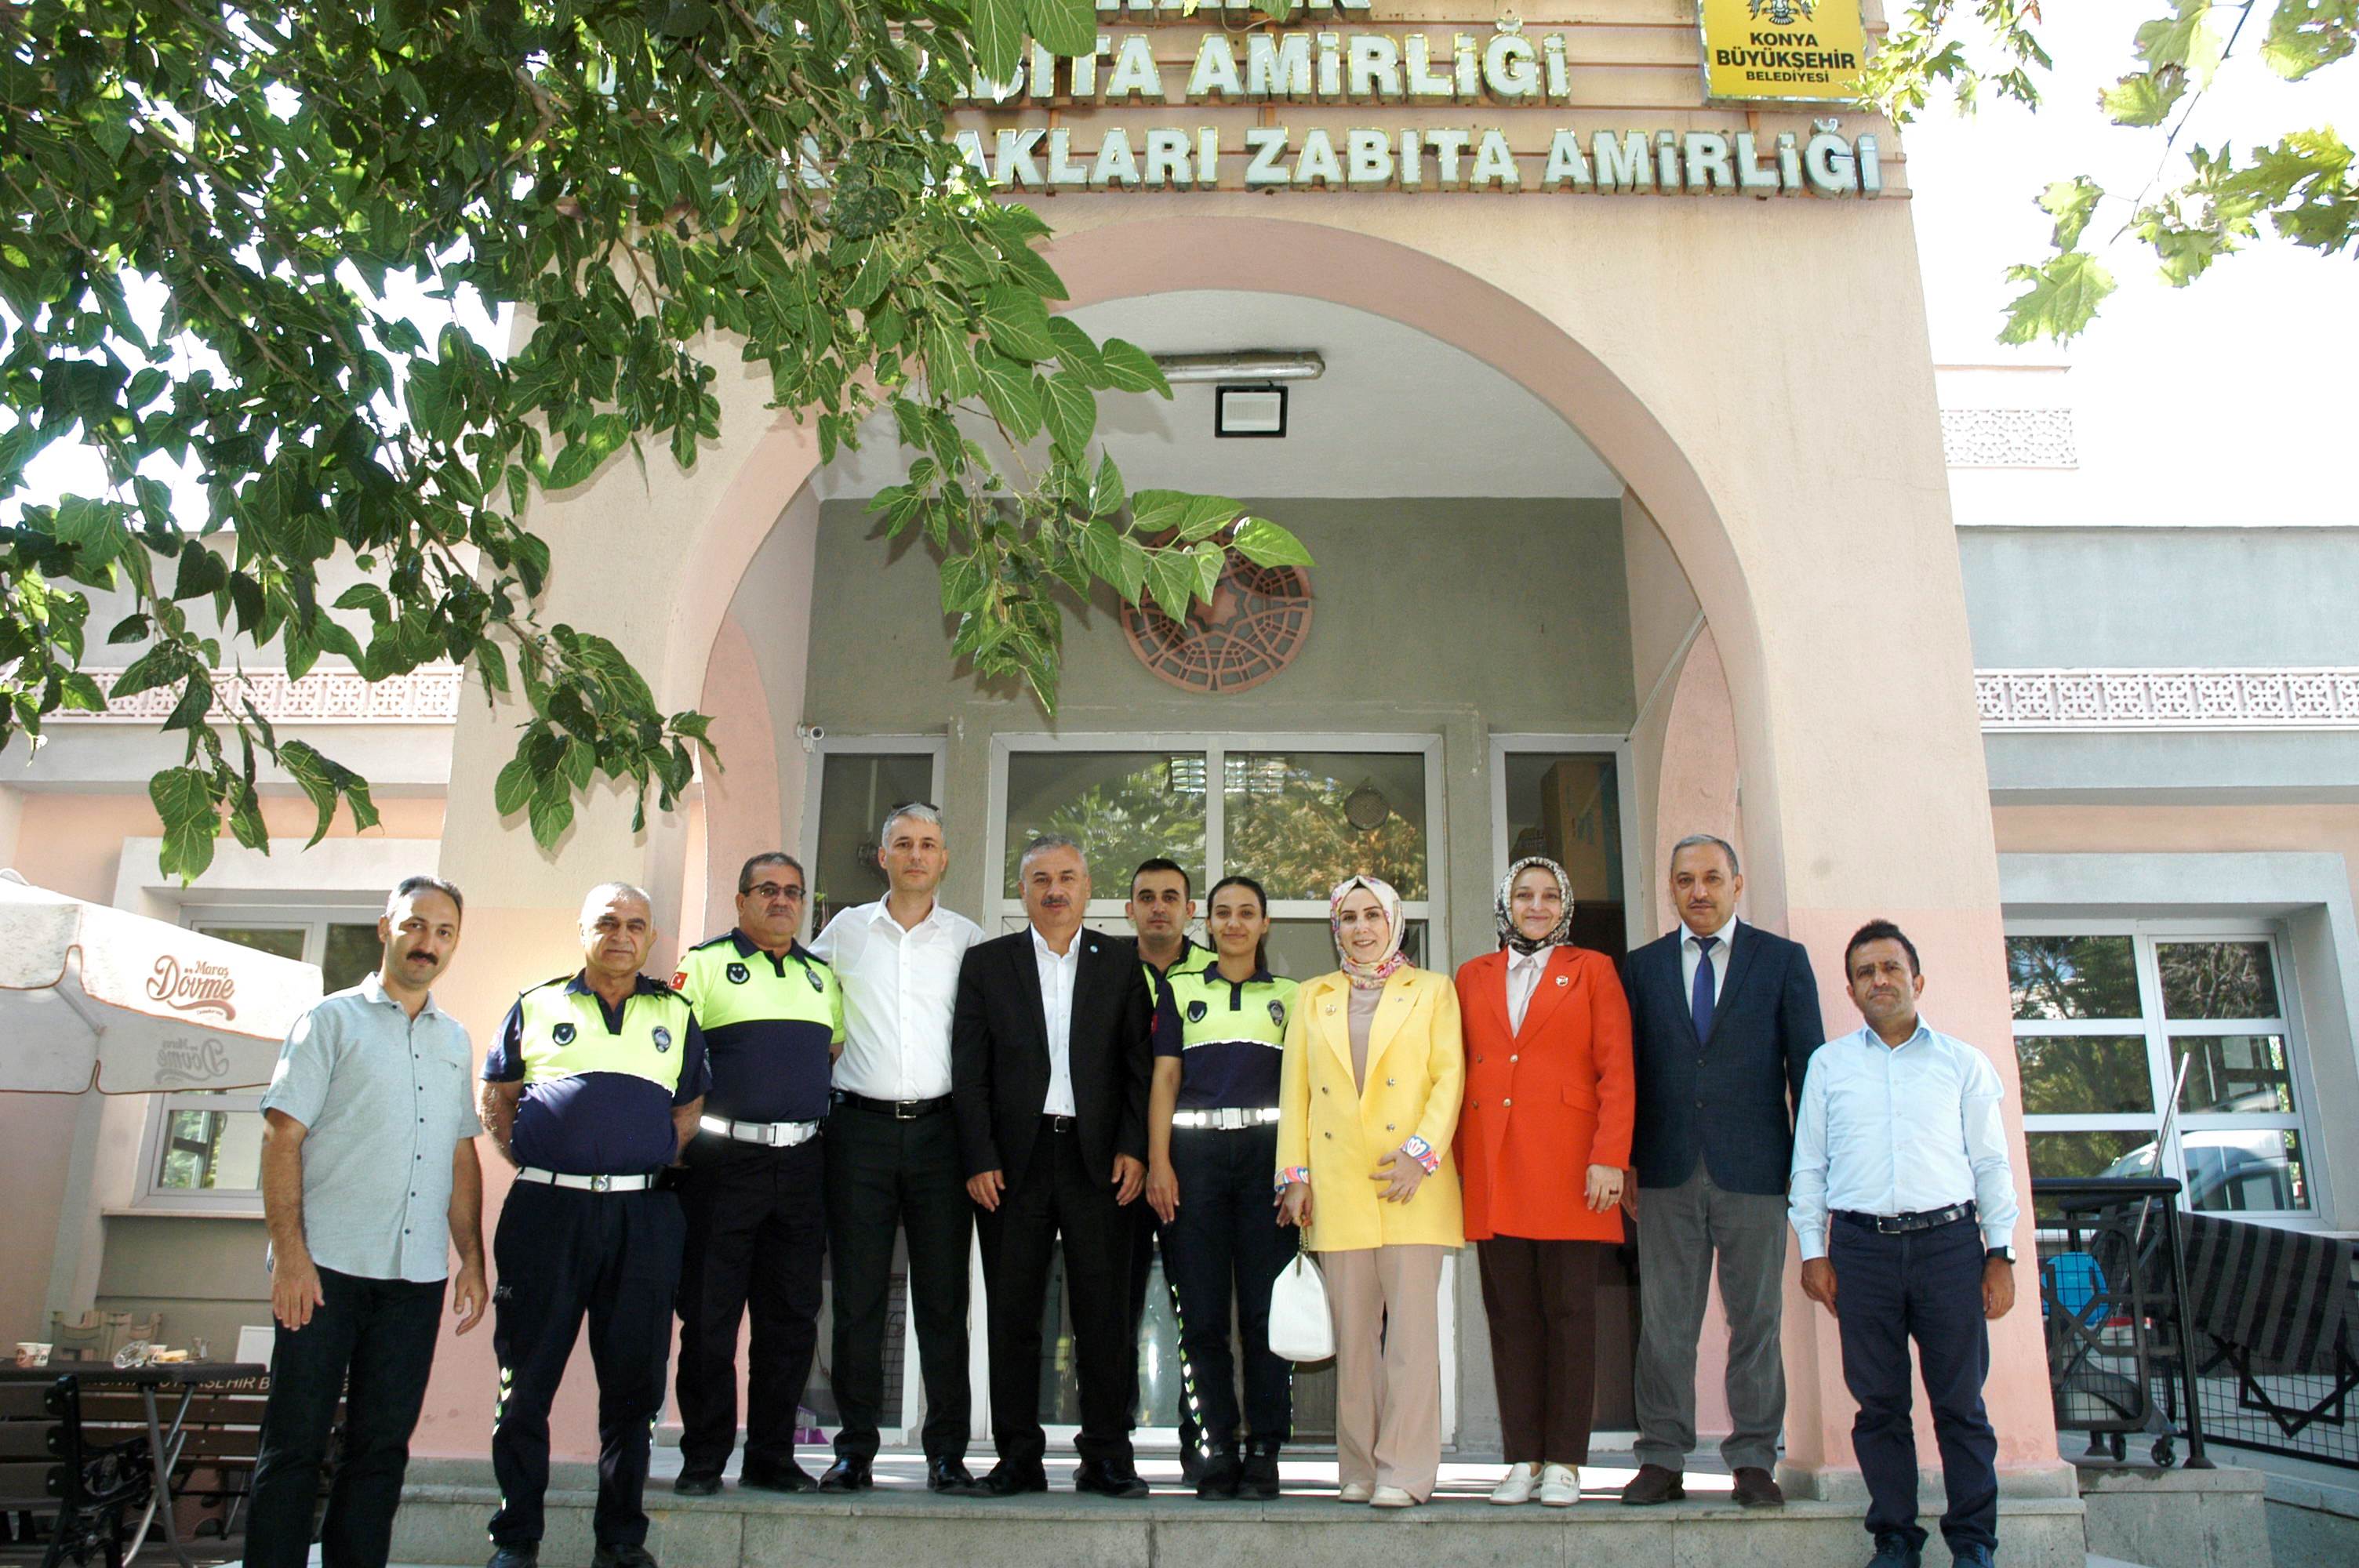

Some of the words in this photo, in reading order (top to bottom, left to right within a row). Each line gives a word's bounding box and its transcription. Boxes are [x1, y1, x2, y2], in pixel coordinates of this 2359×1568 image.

[1750, 32, 1819, 47] KONYA
[1716, 46, 1856, 71] BÜYÜKŞEHİR
[1746, 70, 1830, 83] BELEDİYESİ
[1245, 126, 1520, 188] ZABITA
[146, 954, 235, 1000] Dövme
[194, 960, 230, 978] Maraş
